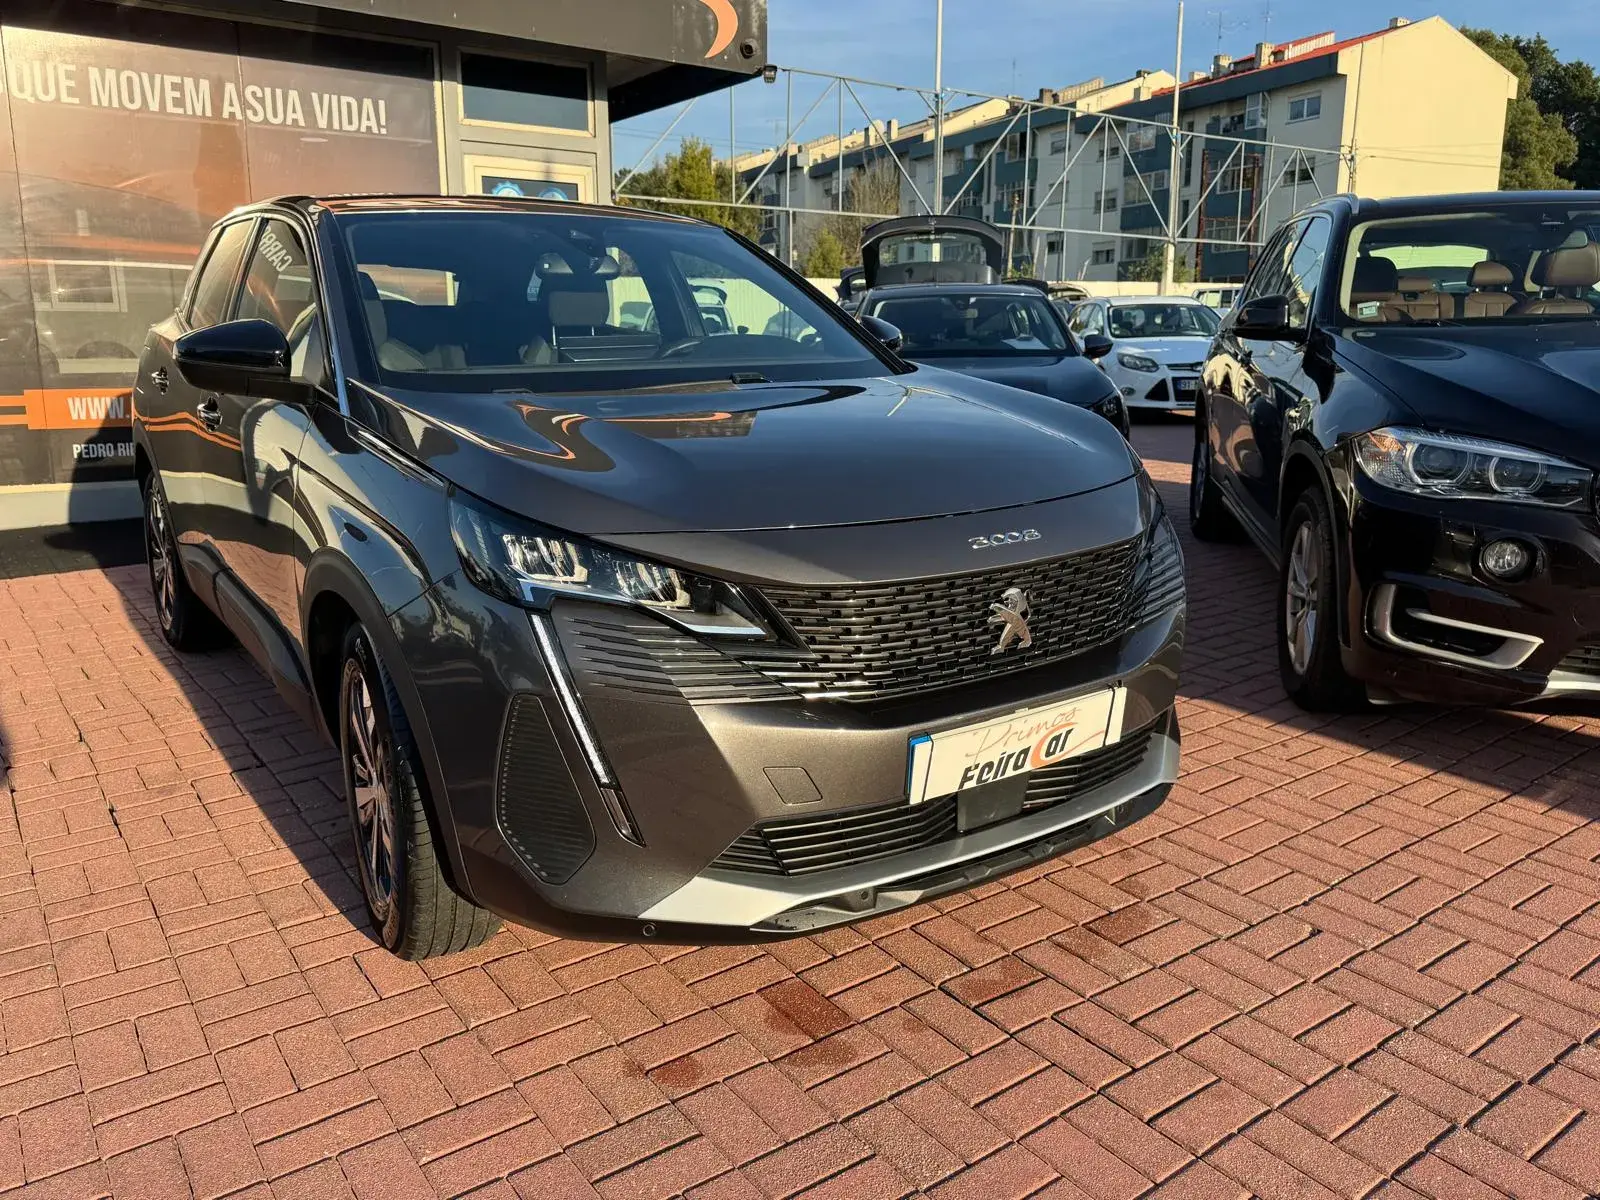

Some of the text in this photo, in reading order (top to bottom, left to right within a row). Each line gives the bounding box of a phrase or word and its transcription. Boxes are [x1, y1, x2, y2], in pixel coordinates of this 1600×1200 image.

[8, 60, 80, 103] QUE
[88, 66, 213, 117] MOVEM
[311, 92, 387, 135] VIDA!
[67, 396, 131, 420] WWW.
[72, 443, 114, 459] PEDRO
[967, 528, 1042, 549] 3008
